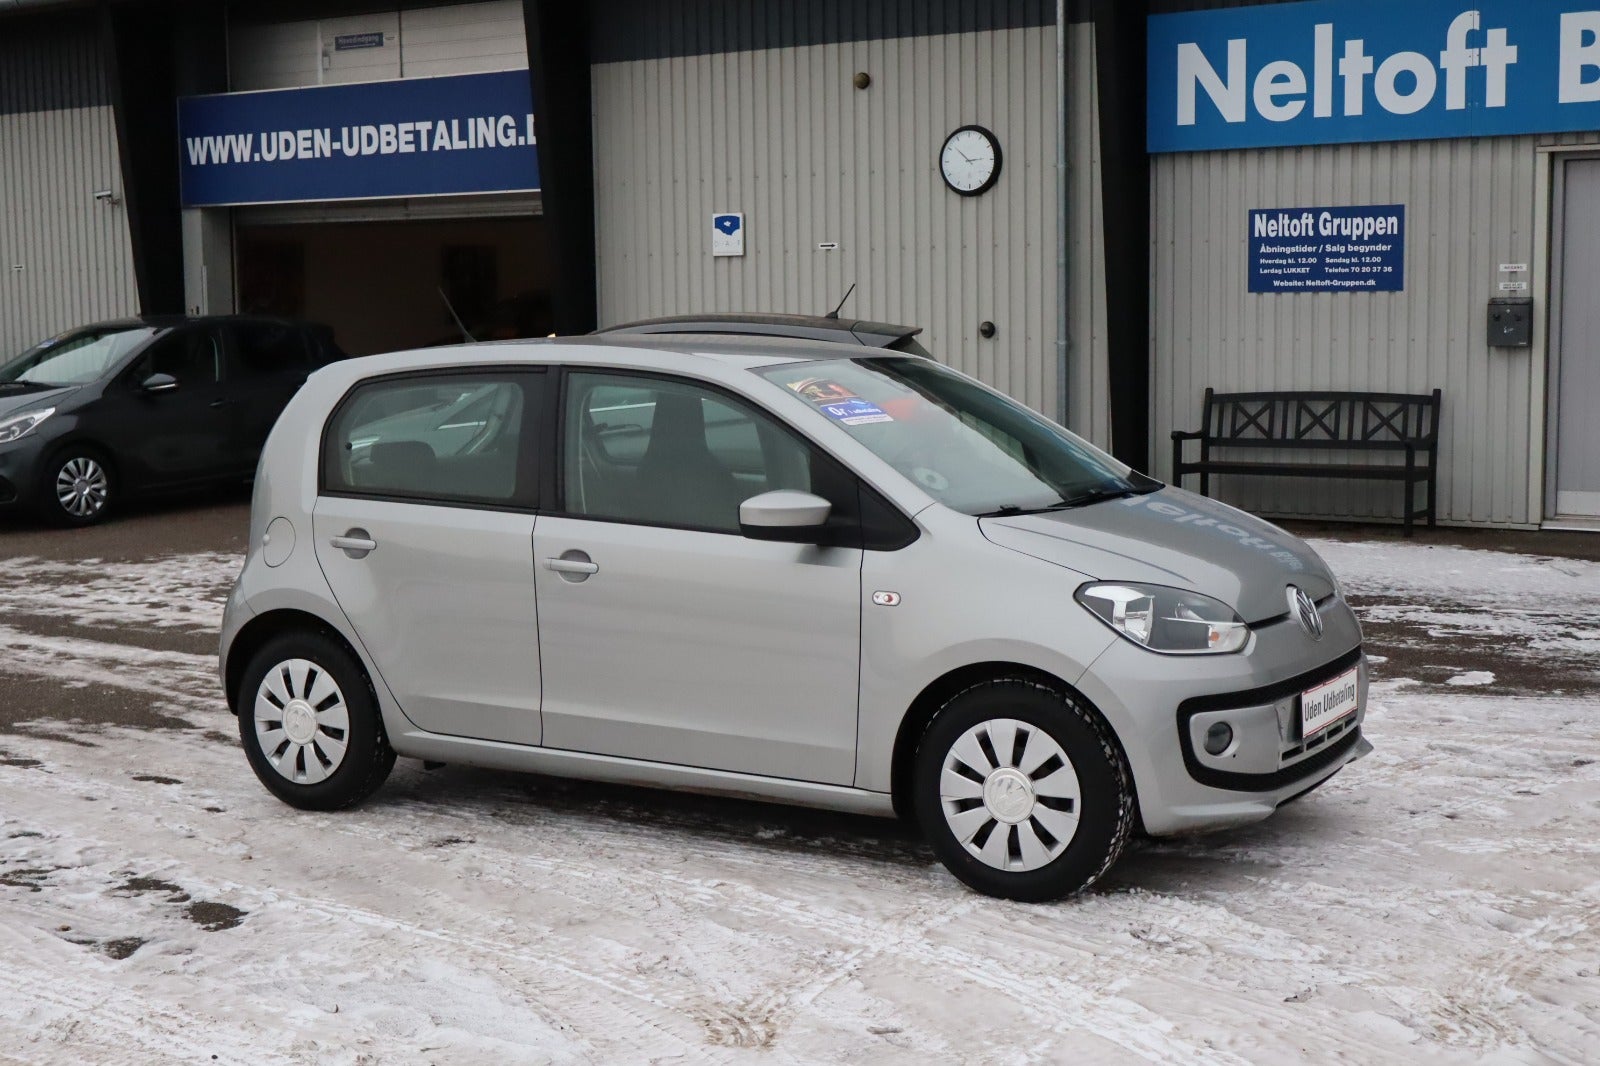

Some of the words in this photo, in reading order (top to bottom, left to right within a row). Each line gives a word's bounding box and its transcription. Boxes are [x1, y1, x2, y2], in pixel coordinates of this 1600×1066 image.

[1177, 10, 1517, 125] Neltoft
[1254, 212, 1314, 238] Neltoft
[1319, 211, 1398, 241] Gruppen
[1260, 243, 1317, 254] Åbningstider
[1325, 243, 1345, 254] Salg
[1347, 243, 1392, 253] begynder
[1306, 279, 1376, 287] Neltoft-Gruppen.dk
[1304, 700, 1322, 722] Uden
[1323, 682, 1355, 713] Udbetaling
